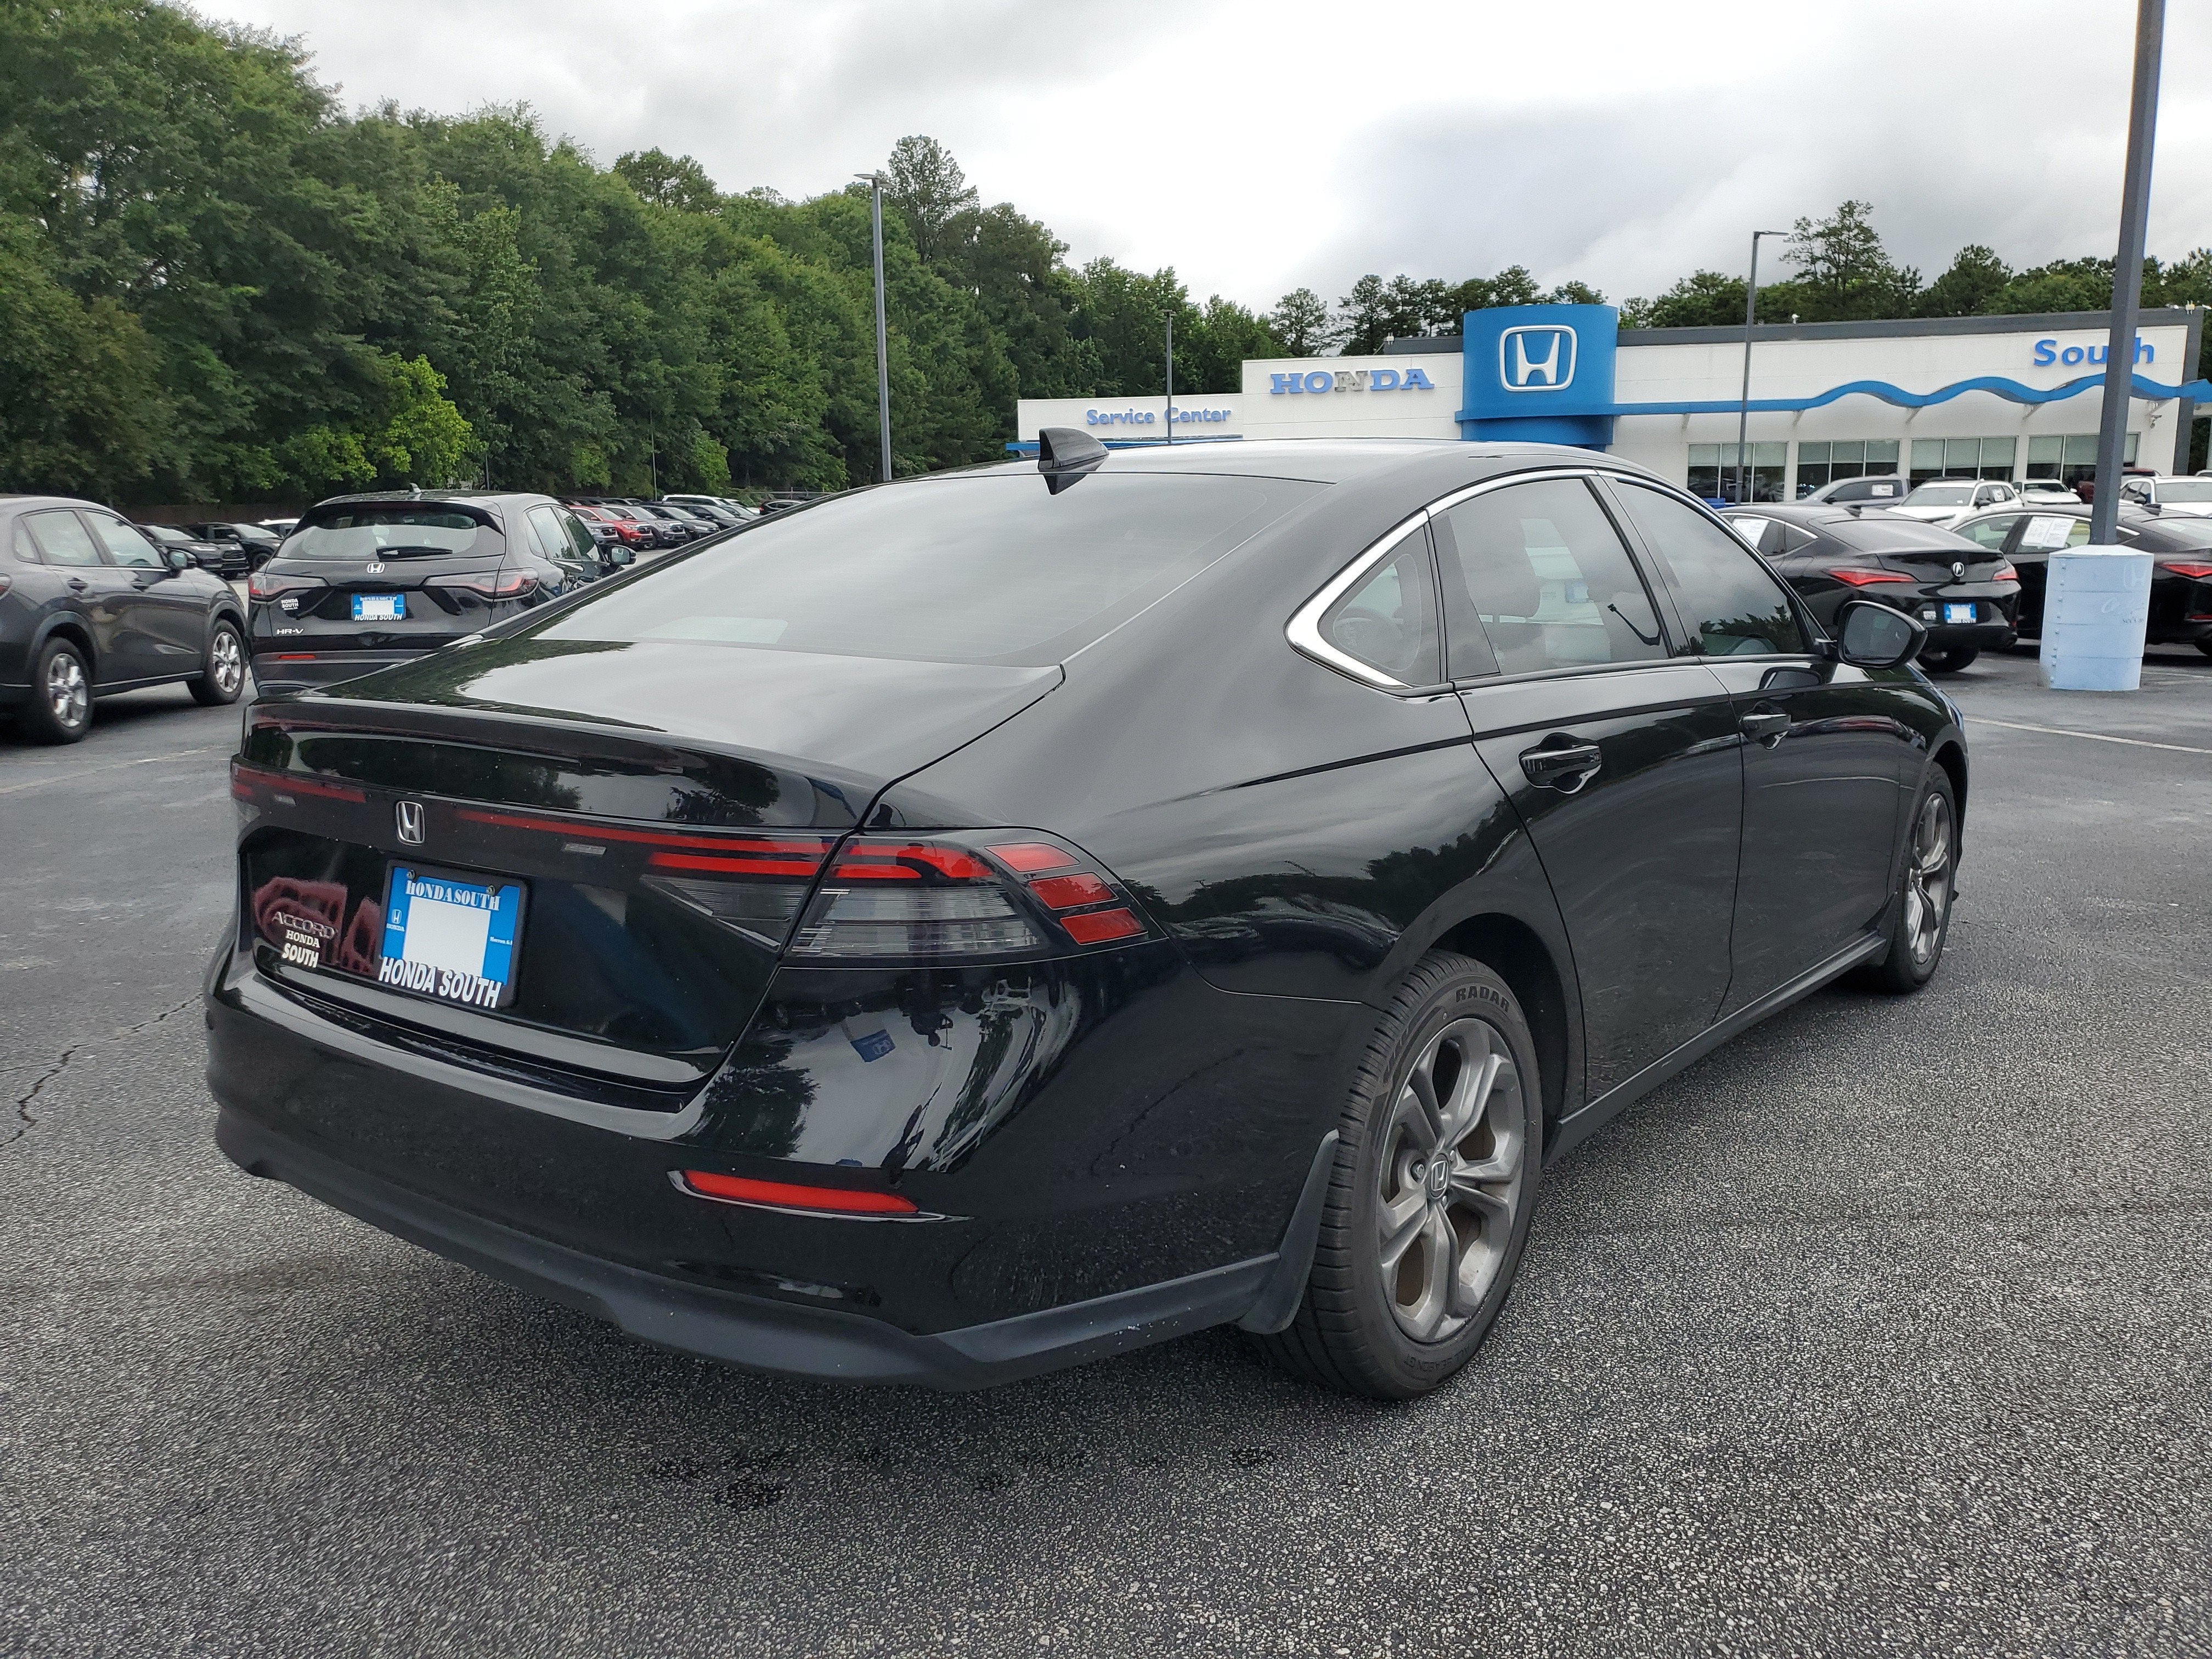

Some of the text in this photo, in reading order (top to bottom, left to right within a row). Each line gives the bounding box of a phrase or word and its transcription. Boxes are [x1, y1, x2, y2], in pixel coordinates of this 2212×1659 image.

[2034, 336, 2155, 366] Souh
[1270, 368, 1435, 394] HONDA
[1087, 407, 1232, 425] Service Center
[272, 911, 335, 940] ACCORD
[286, 929, 320, 948] HONDA
[282, 943, 319, 968] SOUTH
[379, 956, 501, 1008] HONDA SOUTH
[1456, 986, 1510, 1012] RADAR
